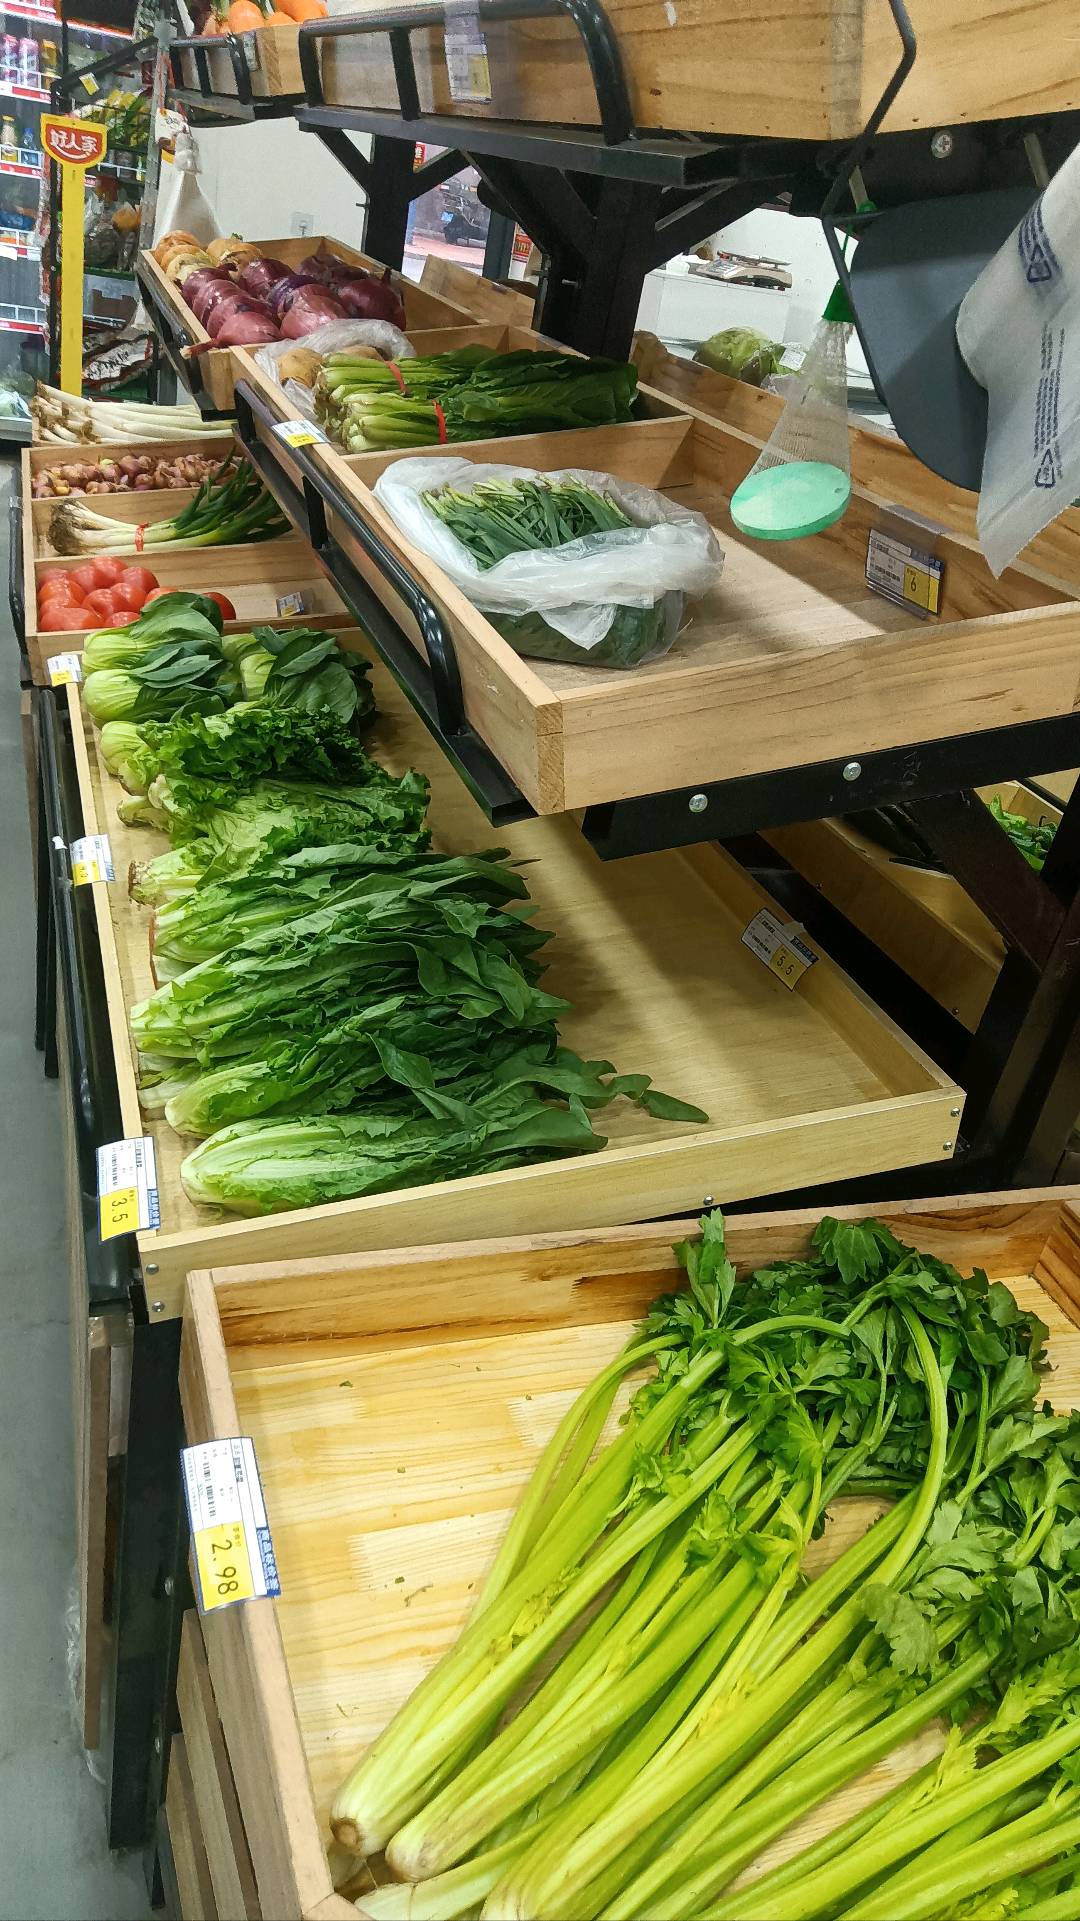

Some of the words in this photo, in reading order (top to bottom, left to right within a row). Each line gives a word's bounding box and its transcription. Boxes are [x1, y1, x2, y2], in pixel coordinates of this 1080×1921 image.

[49, 128, 98, 154] 好人家
[910, 576, 917, 592] 6
[776, 955, 795, 976] 5.5
[112, 1198, 128, 1223] 3.5
[211, 1539, 239, 1595] 2.98
